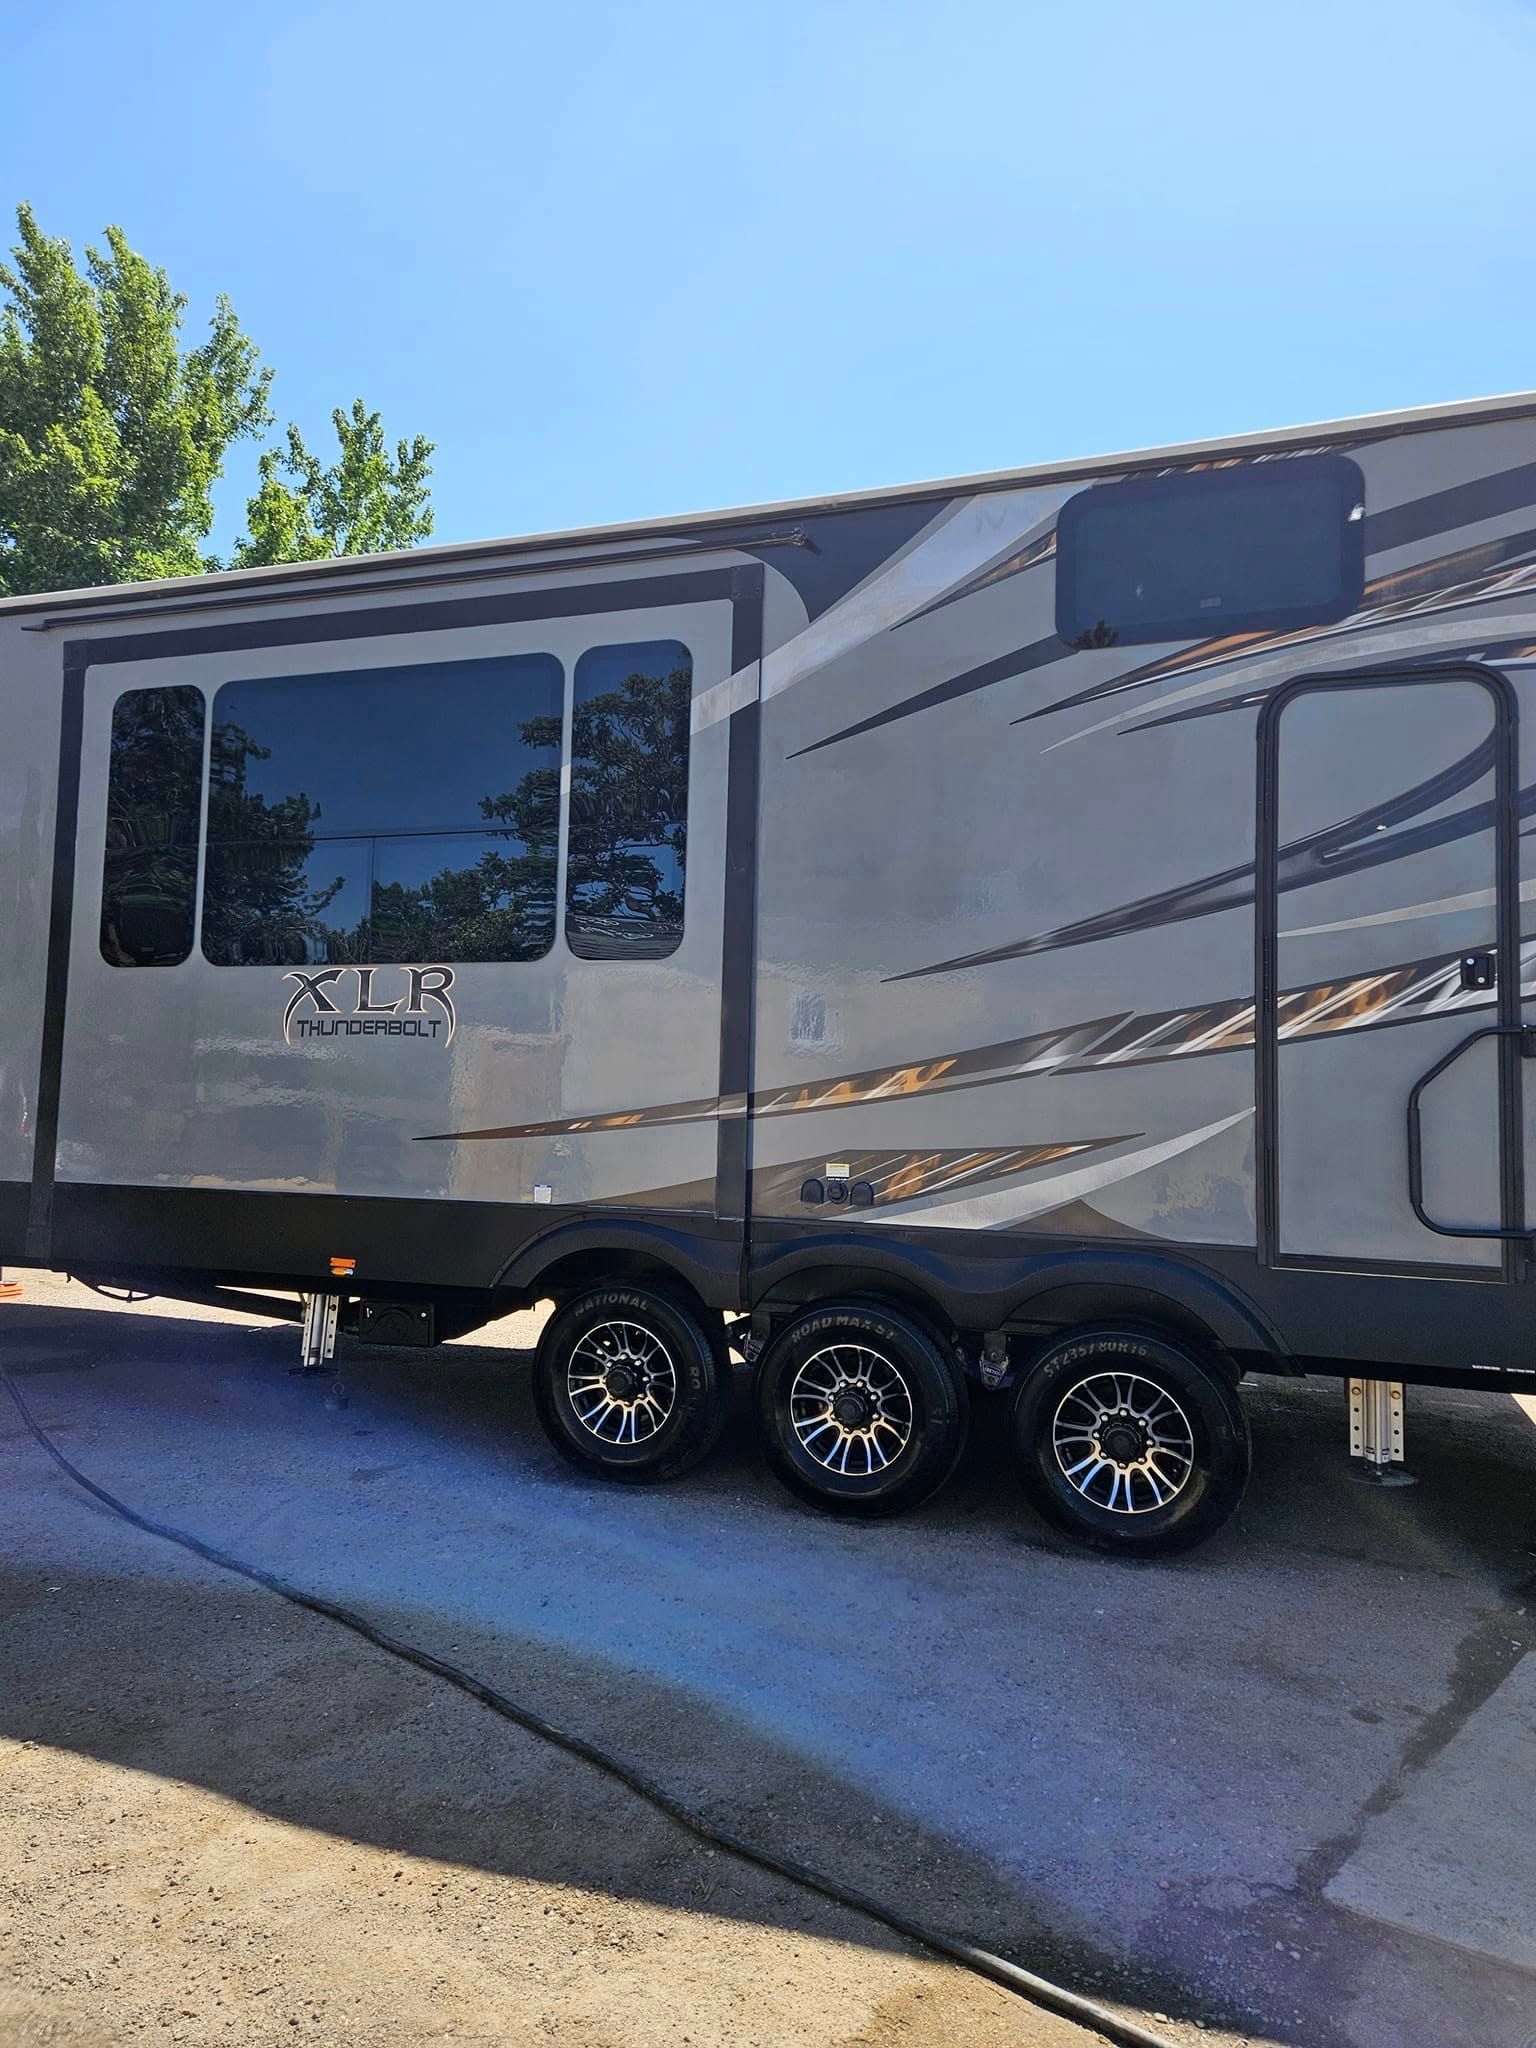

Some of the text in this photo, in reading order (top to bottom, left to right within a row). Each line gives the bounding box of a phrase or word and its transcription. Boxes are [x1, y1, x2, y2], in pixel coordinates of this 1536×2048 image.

[281, 965, 456, 1048] XLR
[296, 1019, 442, 1039] THUNDERBOLT
[575, 1293, 648, 1316] NATIONAL
[791, 1317, 833, 1342] ROAD
[837, 1316, 873, 1330] MAX
